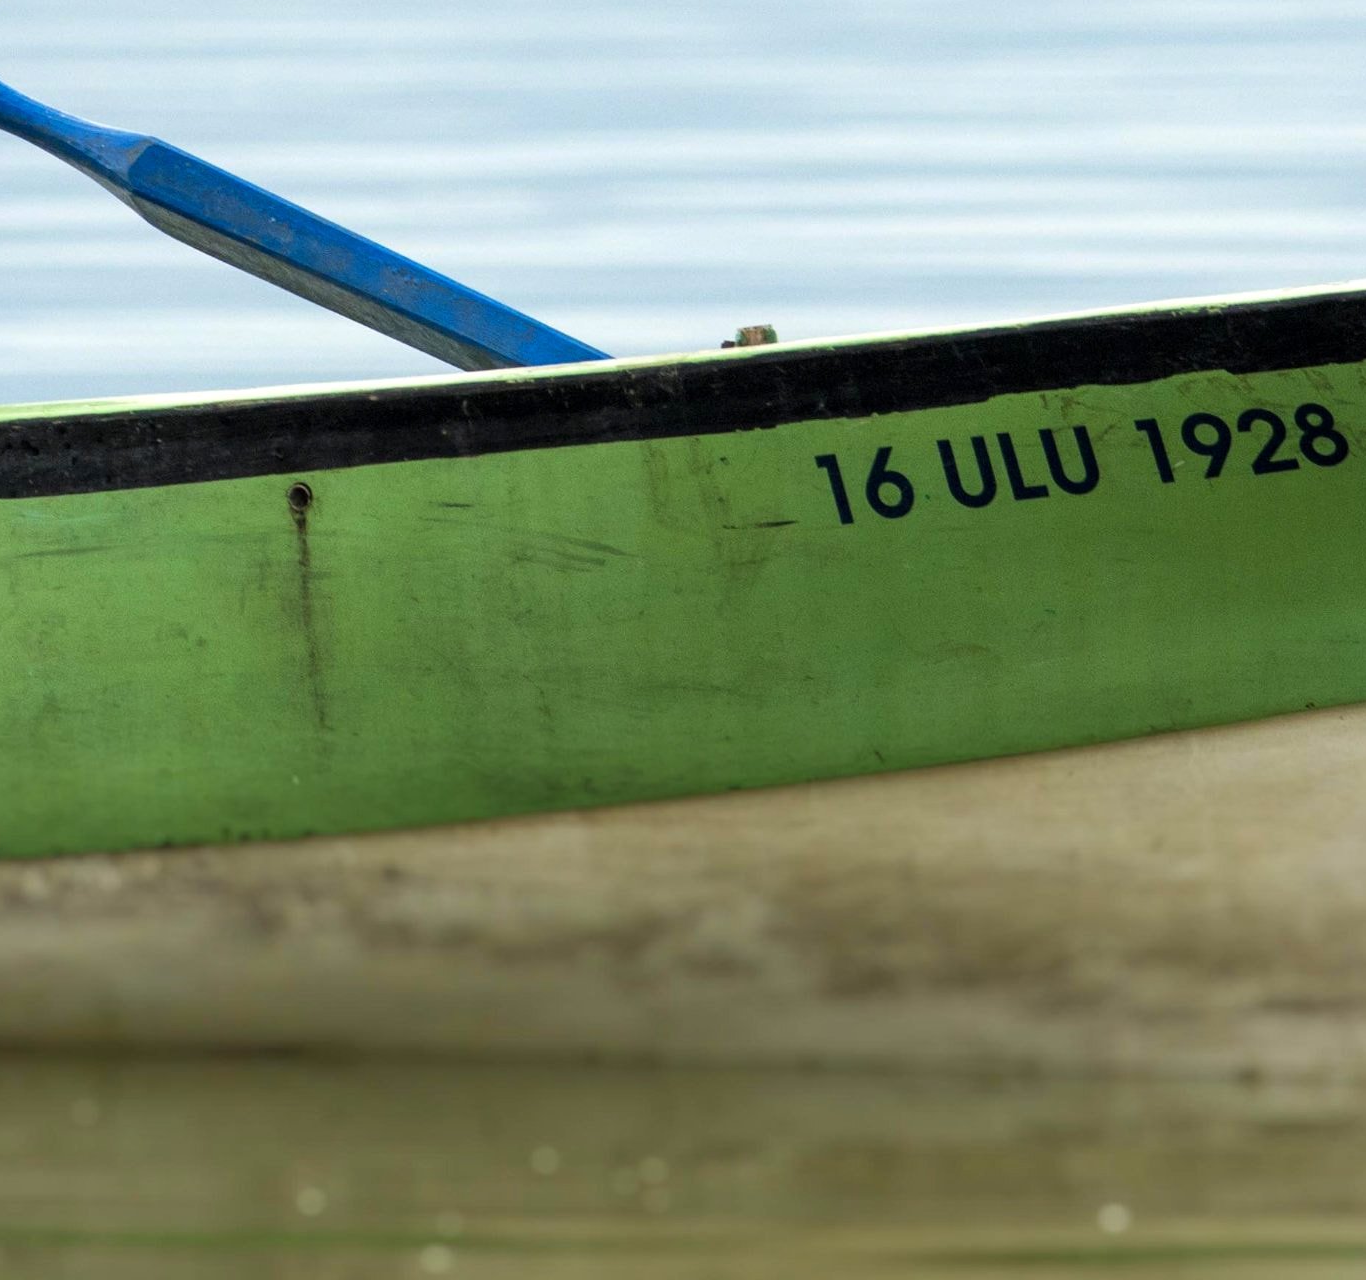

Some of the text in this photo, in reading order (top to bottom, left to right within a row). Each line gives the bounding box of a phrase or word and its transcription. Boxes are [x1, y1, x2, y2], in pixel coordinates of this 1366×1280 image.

[813, 402, 1351, 525] 16 ULU 1928
